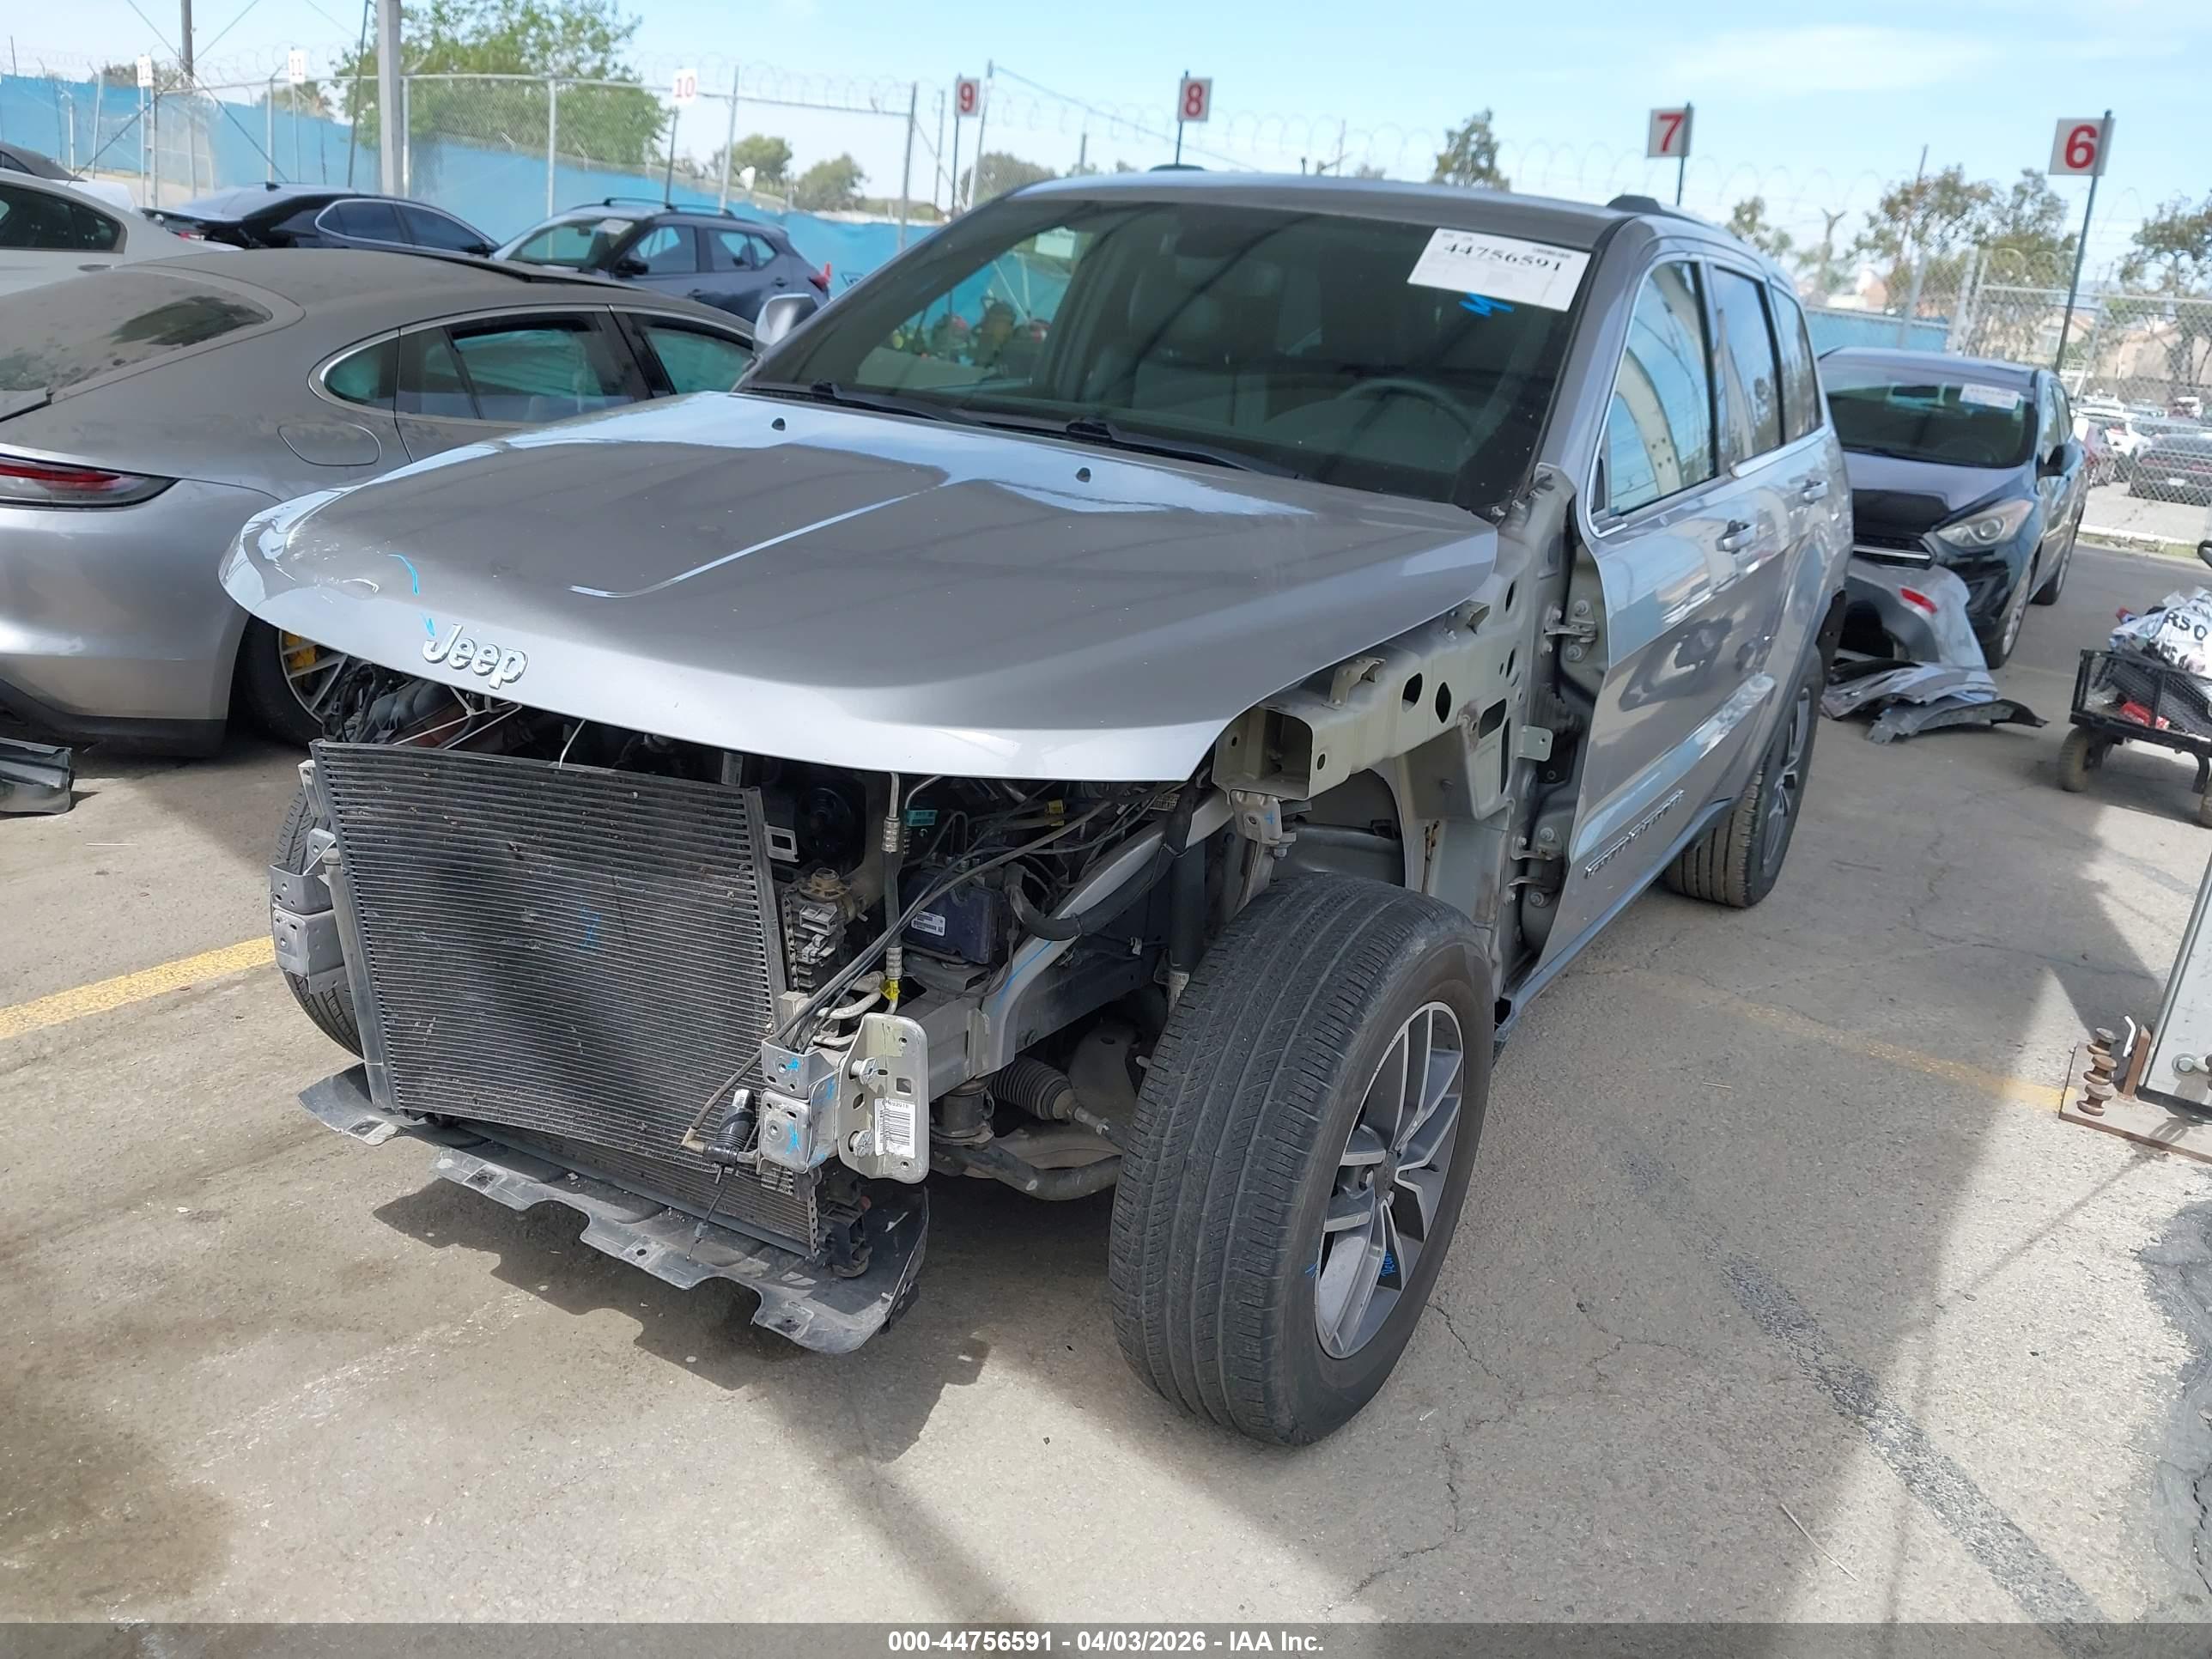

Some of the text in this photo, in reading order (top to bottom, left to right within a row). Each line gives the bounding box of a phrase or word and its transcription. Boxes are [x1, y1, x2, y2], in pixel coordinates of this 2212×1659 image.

[138, 62, 150, 80] 12
[289, 58, 303, 76] 11
[675, 76, 696, 98] 10
[960, 82, 974, 112] 9
[1185, 82, 1203, 117] 8
[1658, 113, 1686, 153] 7
[2065, 124, 2098, 170] 6
[1443, 242, 1562, 272] 44756591
[422, 623, 529, 690] Jeep
